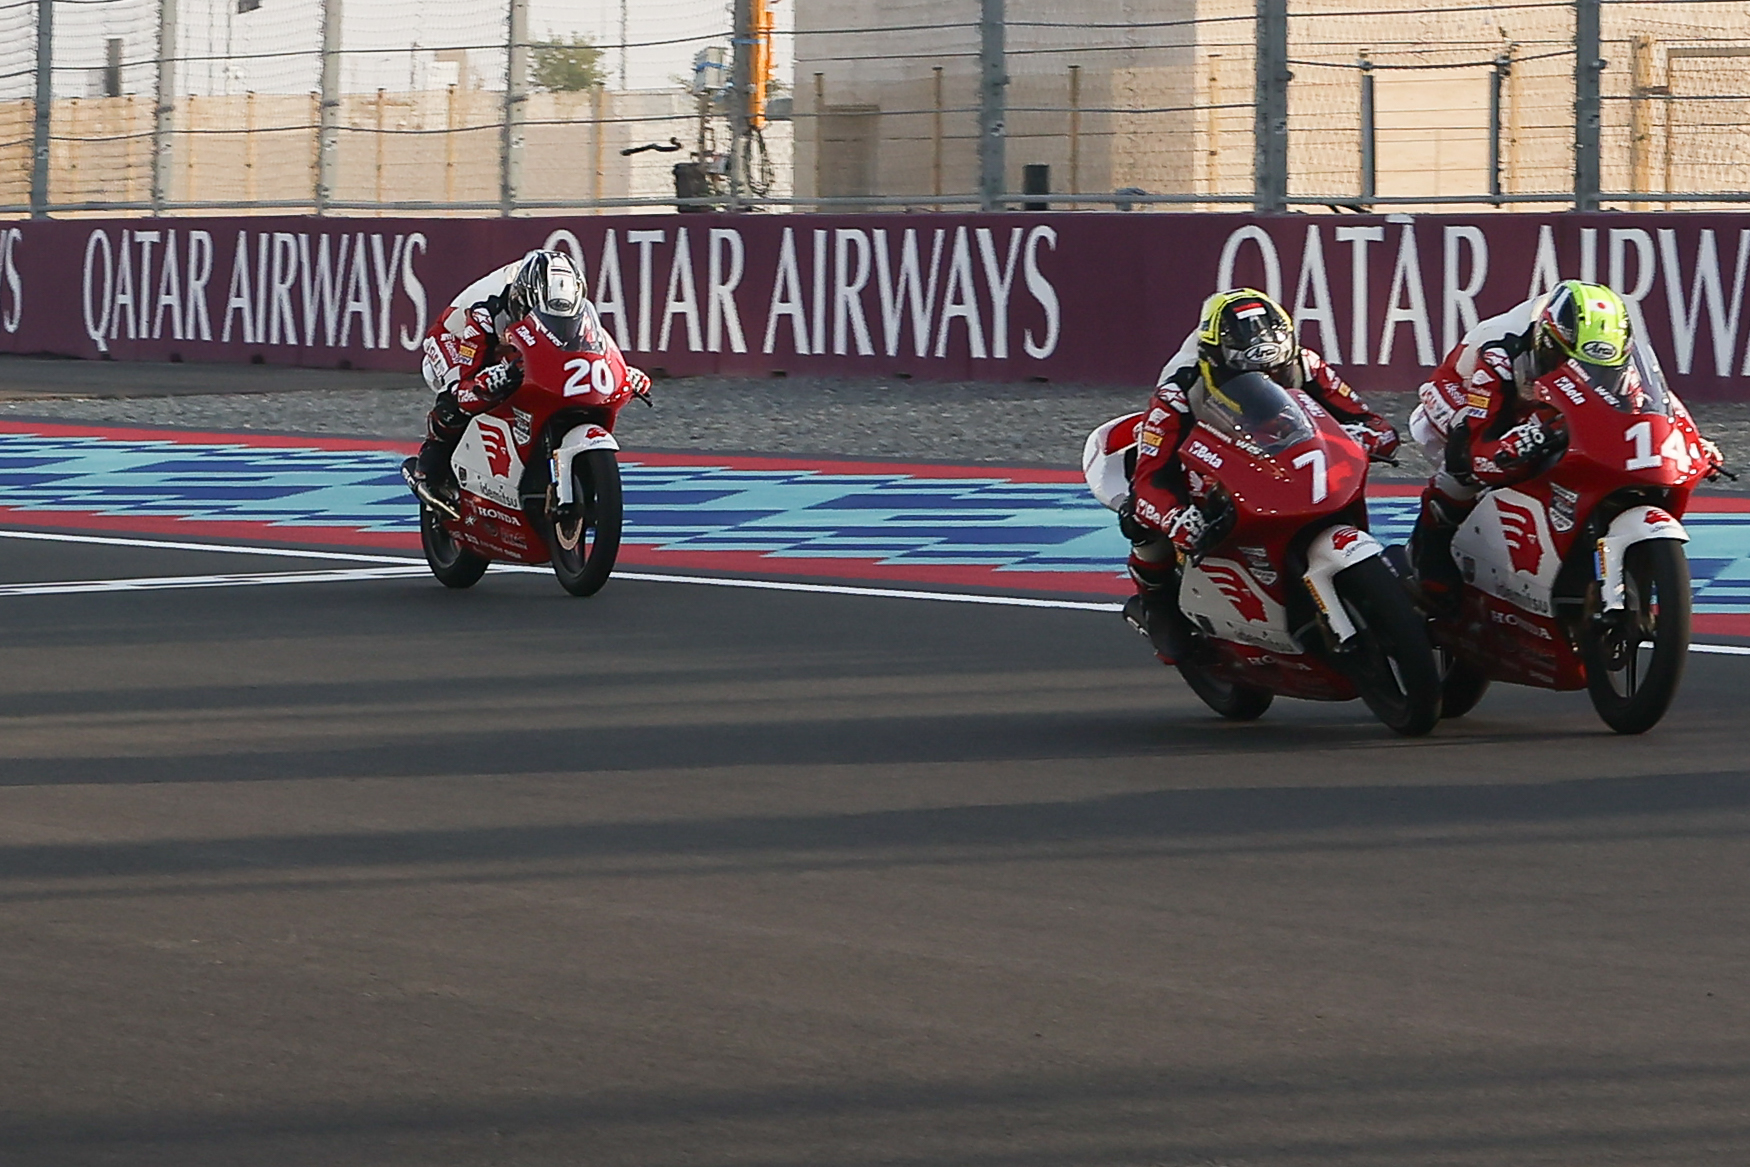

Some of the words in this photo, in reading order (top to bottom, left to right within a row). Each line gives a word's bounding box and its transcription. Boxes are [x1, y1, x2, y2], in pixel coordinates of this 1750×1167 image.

[82, 228, 212, 352] QATAR
[222, 231, 427, 351] AIRWAYS
[763, 225, 1061, 360] AIRWAYS
[563, 358, 615, 397] 20
[1196, 444, 1224, 469] Beta
[1624, 421, 1693, 473] 14
[479, 482, 518, 508] idemitsu
[1292, 449, 1328, 504] 7
[478, 506, 521, 527] HONDA
